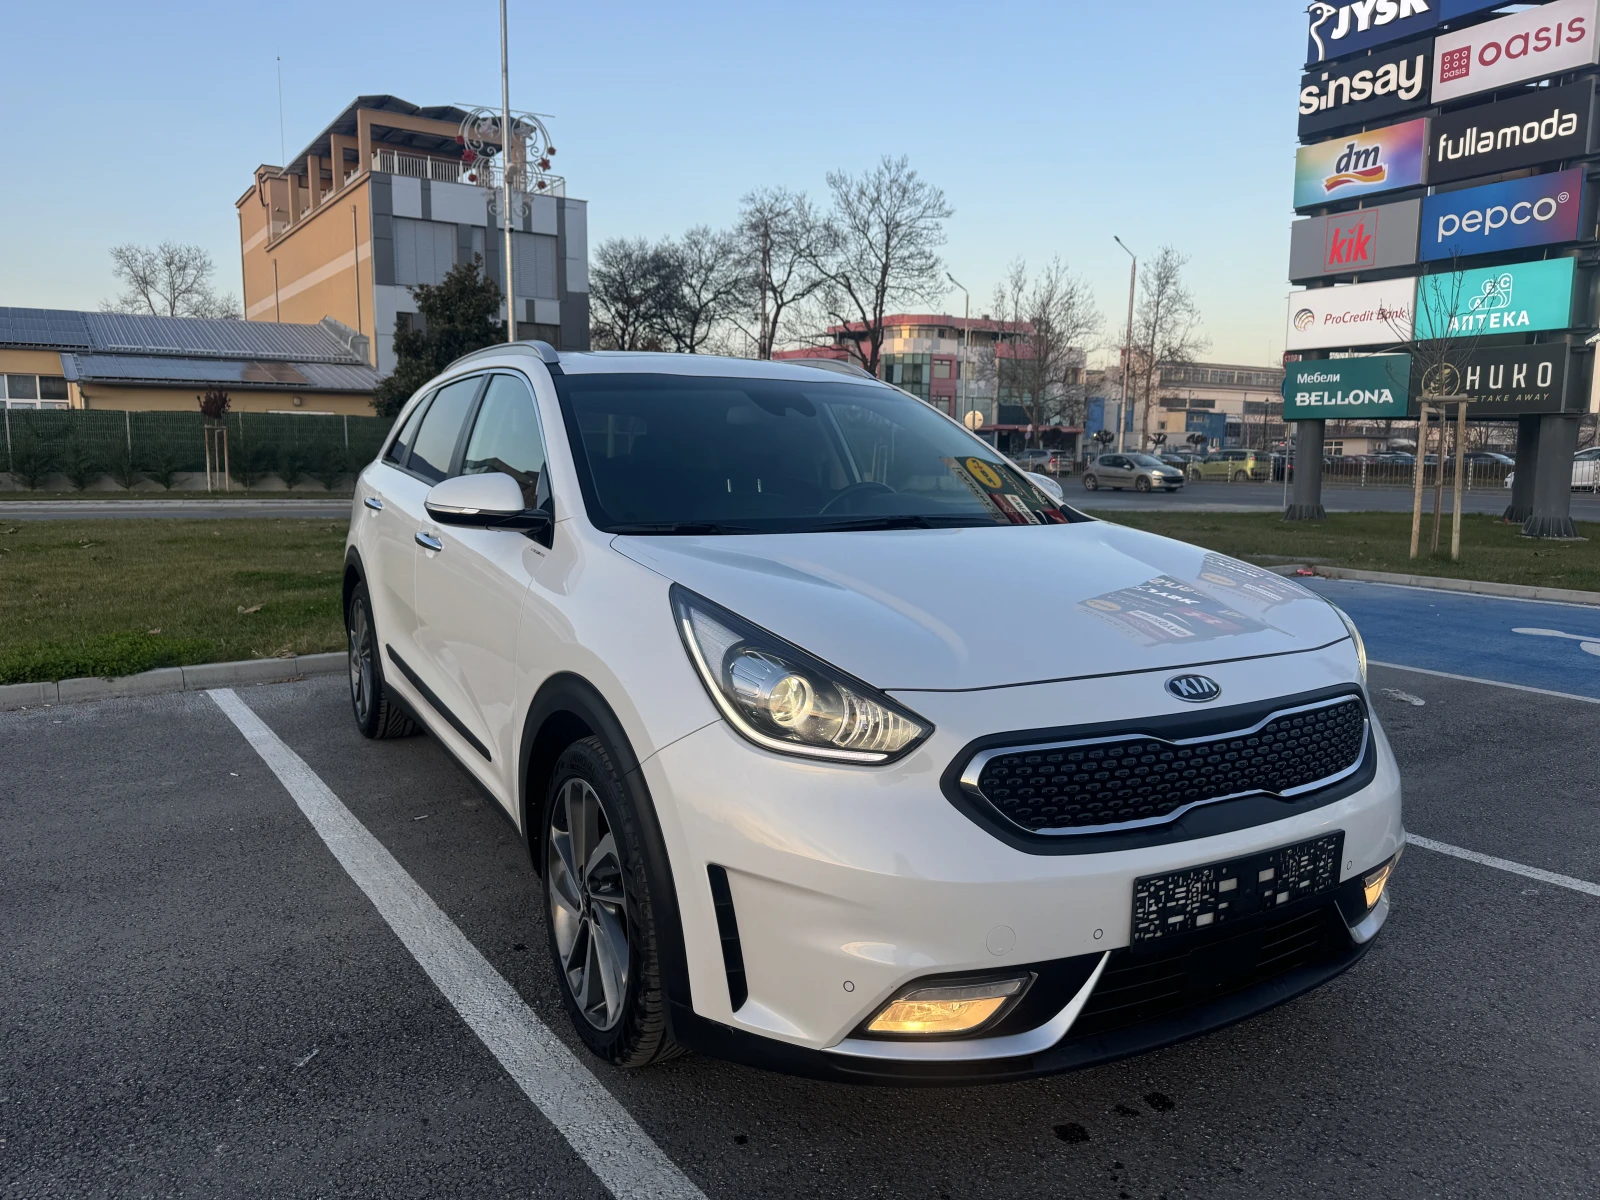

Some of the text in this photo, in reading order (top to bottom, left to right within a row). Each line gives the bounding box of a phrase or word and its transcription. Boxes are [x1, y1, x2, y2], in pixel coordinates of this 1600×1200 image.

[1478, 17, 1586, 66] oasis
[1443, 67, 1467, 79] oasis
[1299, 54, 1424, 115] sinsay
[1438, 109, 1578, 162] fullamoda
[1335, 144, 1380, 174] dm
[1437, 197, 1557, 242] pepco
[1328, 219, 1373, 265] kik
[1324, 307, 1405, 325] ProCredit Bank
[1448, 310, 1530, 332] АПТЕКА
[1297, 372, 1341, 384] Мебели
[1295, 389, 1394, 406] BELLONA
[1480, 393, 1550, 402] TAKE AWAY
[1173, 677, 1217, 696] KIA
